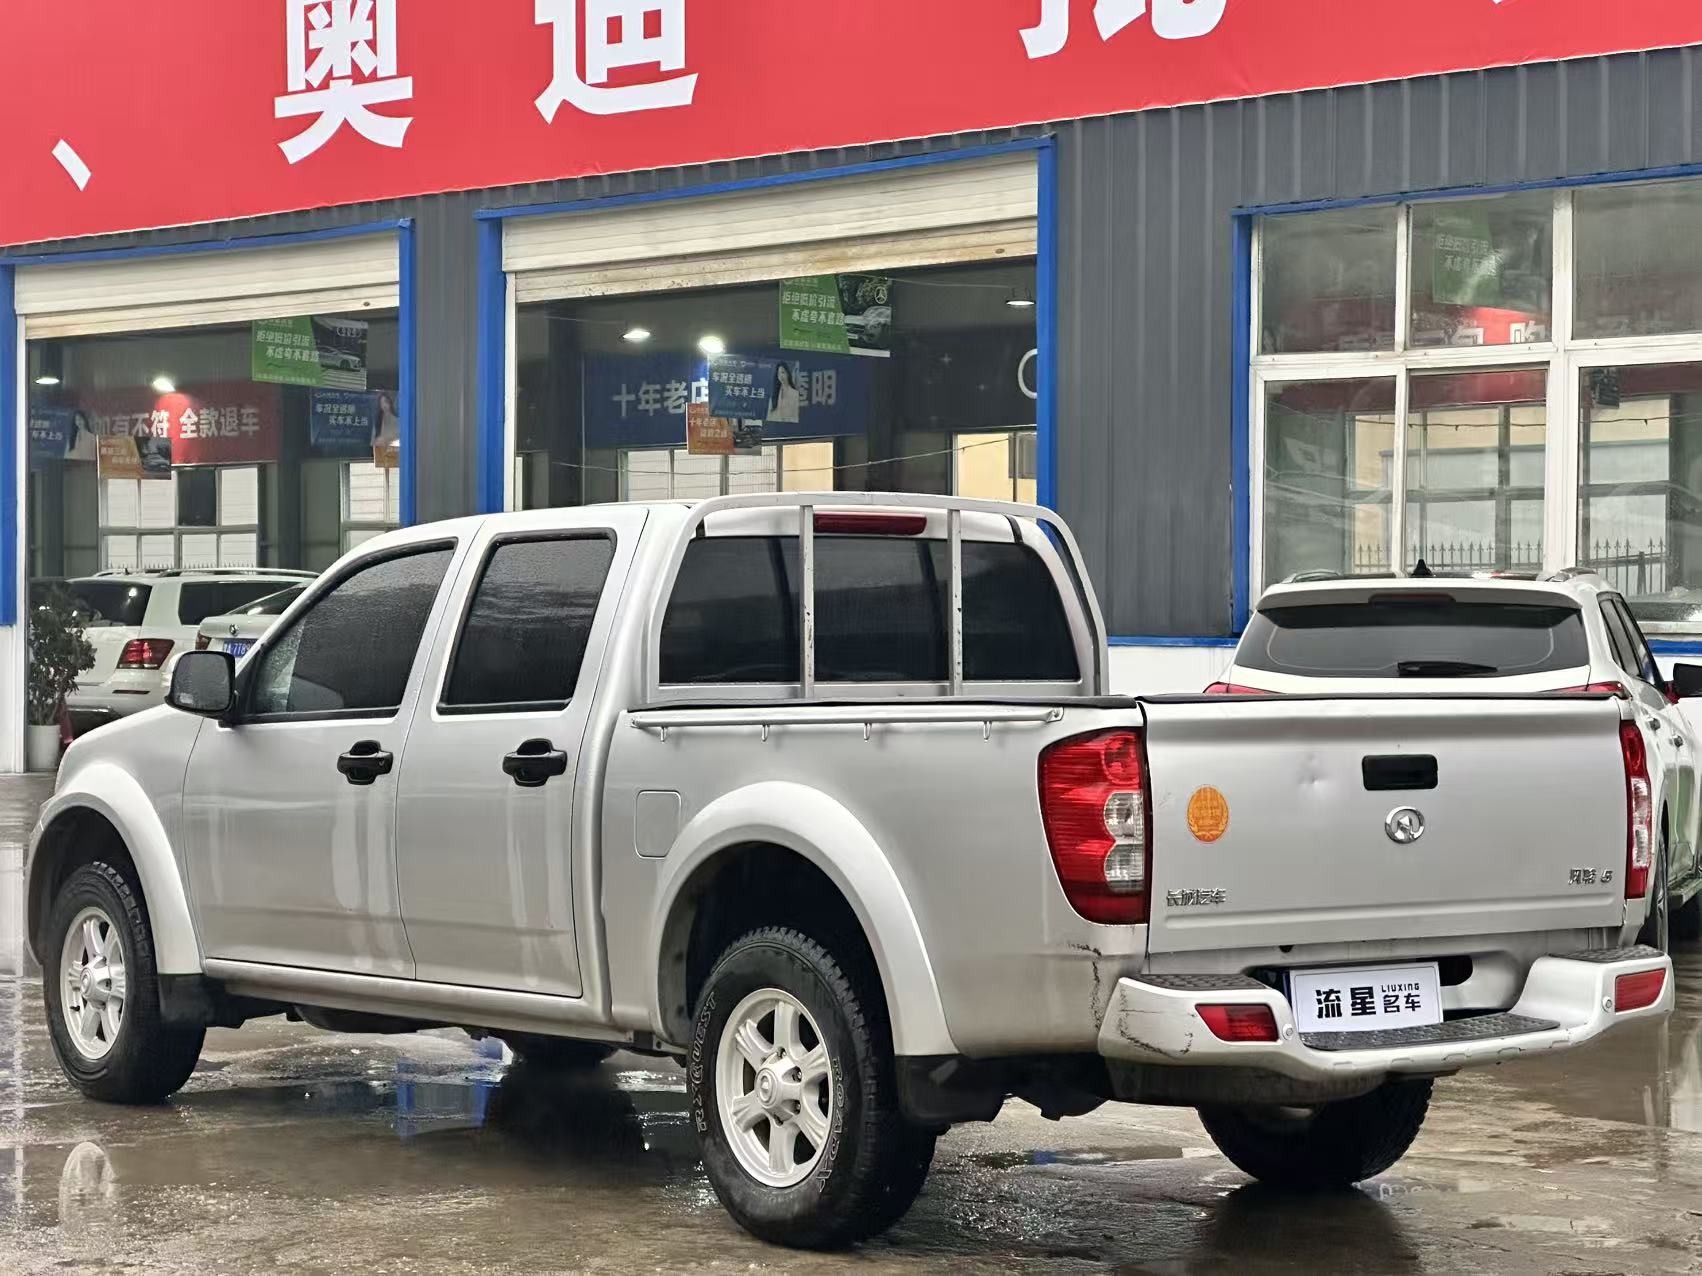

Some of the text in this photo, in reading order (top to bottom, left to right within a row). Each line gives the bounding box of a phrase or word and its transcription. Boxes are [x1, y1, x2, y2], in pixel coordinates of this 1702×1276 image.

[179, 407, 260, 439] 全款退车
[1600, 869, 1613, 884] 5
[1165, 888, 1227, 907] 长城汽车
[1383, 993, 1422, 1014] 名车
